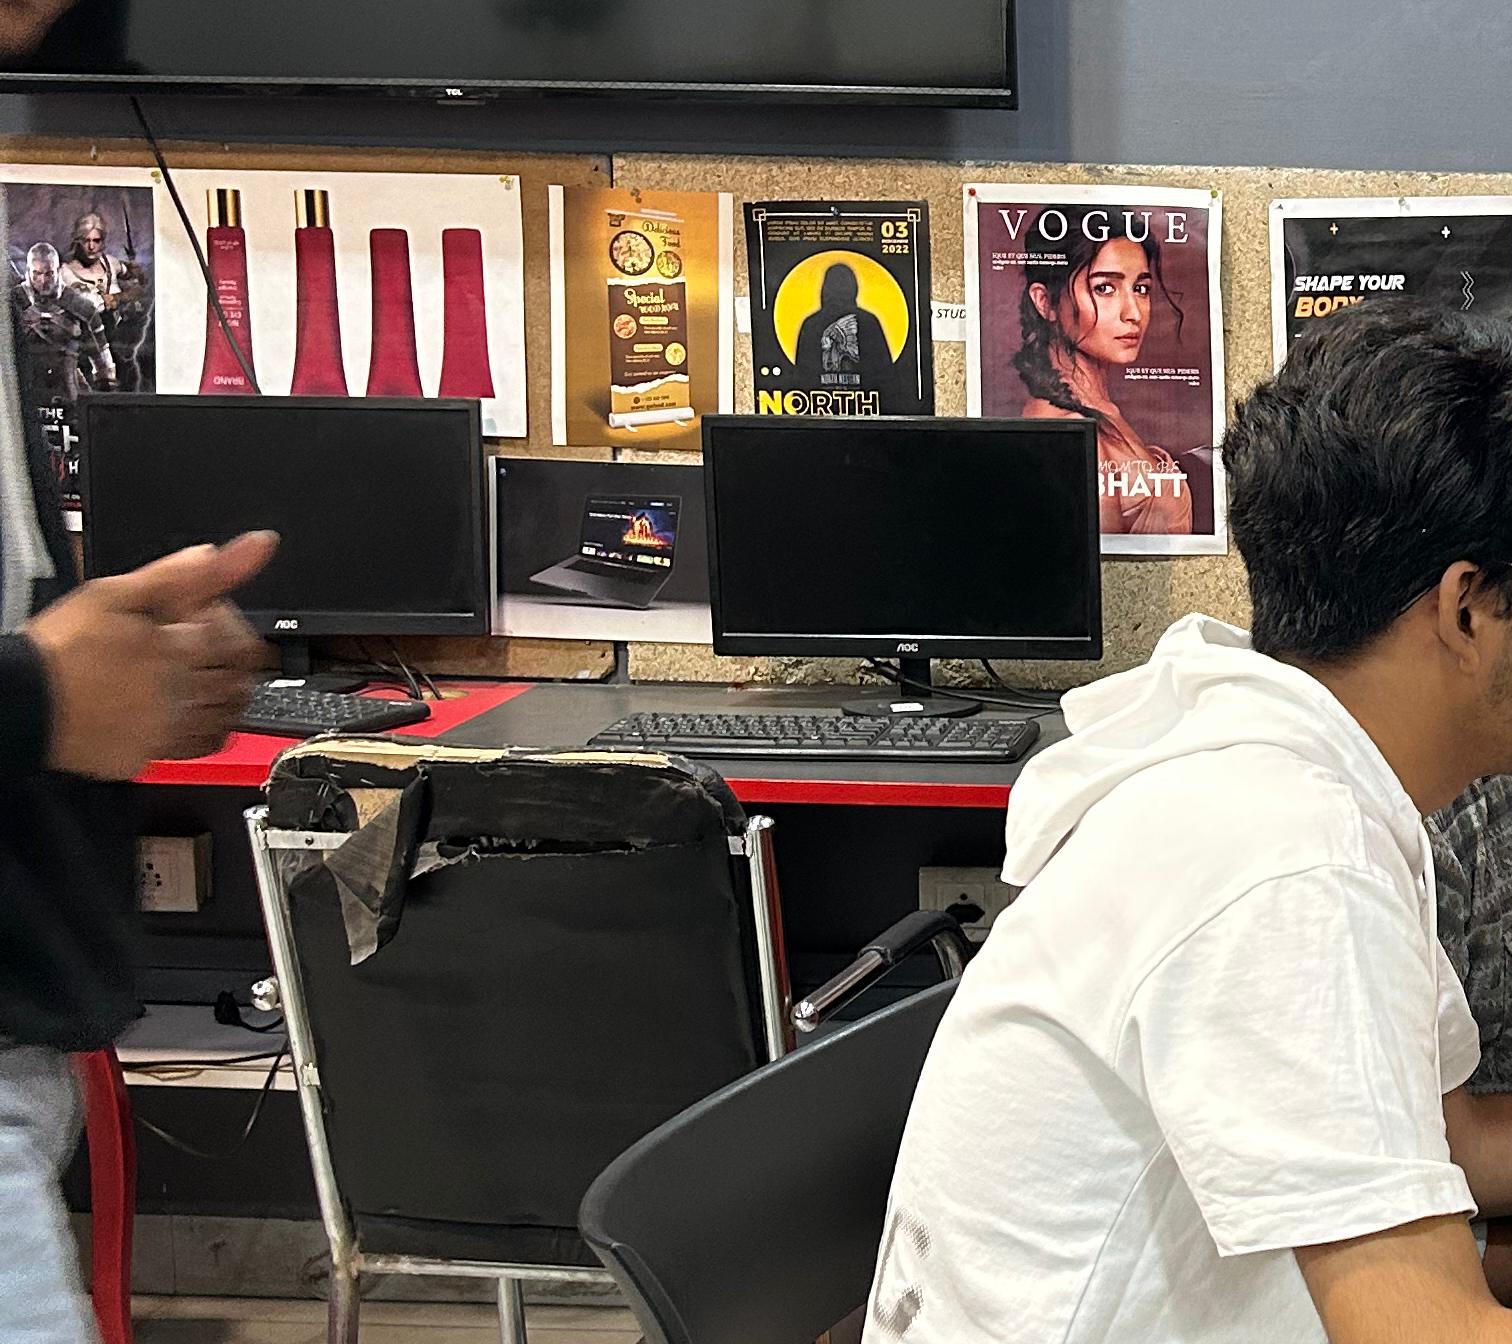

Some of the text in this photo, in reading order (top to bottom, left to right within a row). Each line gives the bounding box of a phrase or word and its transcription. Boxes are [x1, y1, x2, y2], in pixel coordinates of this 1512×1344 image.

[881, 221, 909, 238] 03
[998, 209, 1188, 243] VOGUE
[881, 244, 910, 254] 2022
[1294, 275, 1405, 291] SHAPE YOUR
[624, 287, 666, 308] Special
[758, 390, 880, 416] NORTH
[37, 407, 64, 420] THE
[274, 620, 298, 629] AOC
[897, 642, 919, 652] AOC
